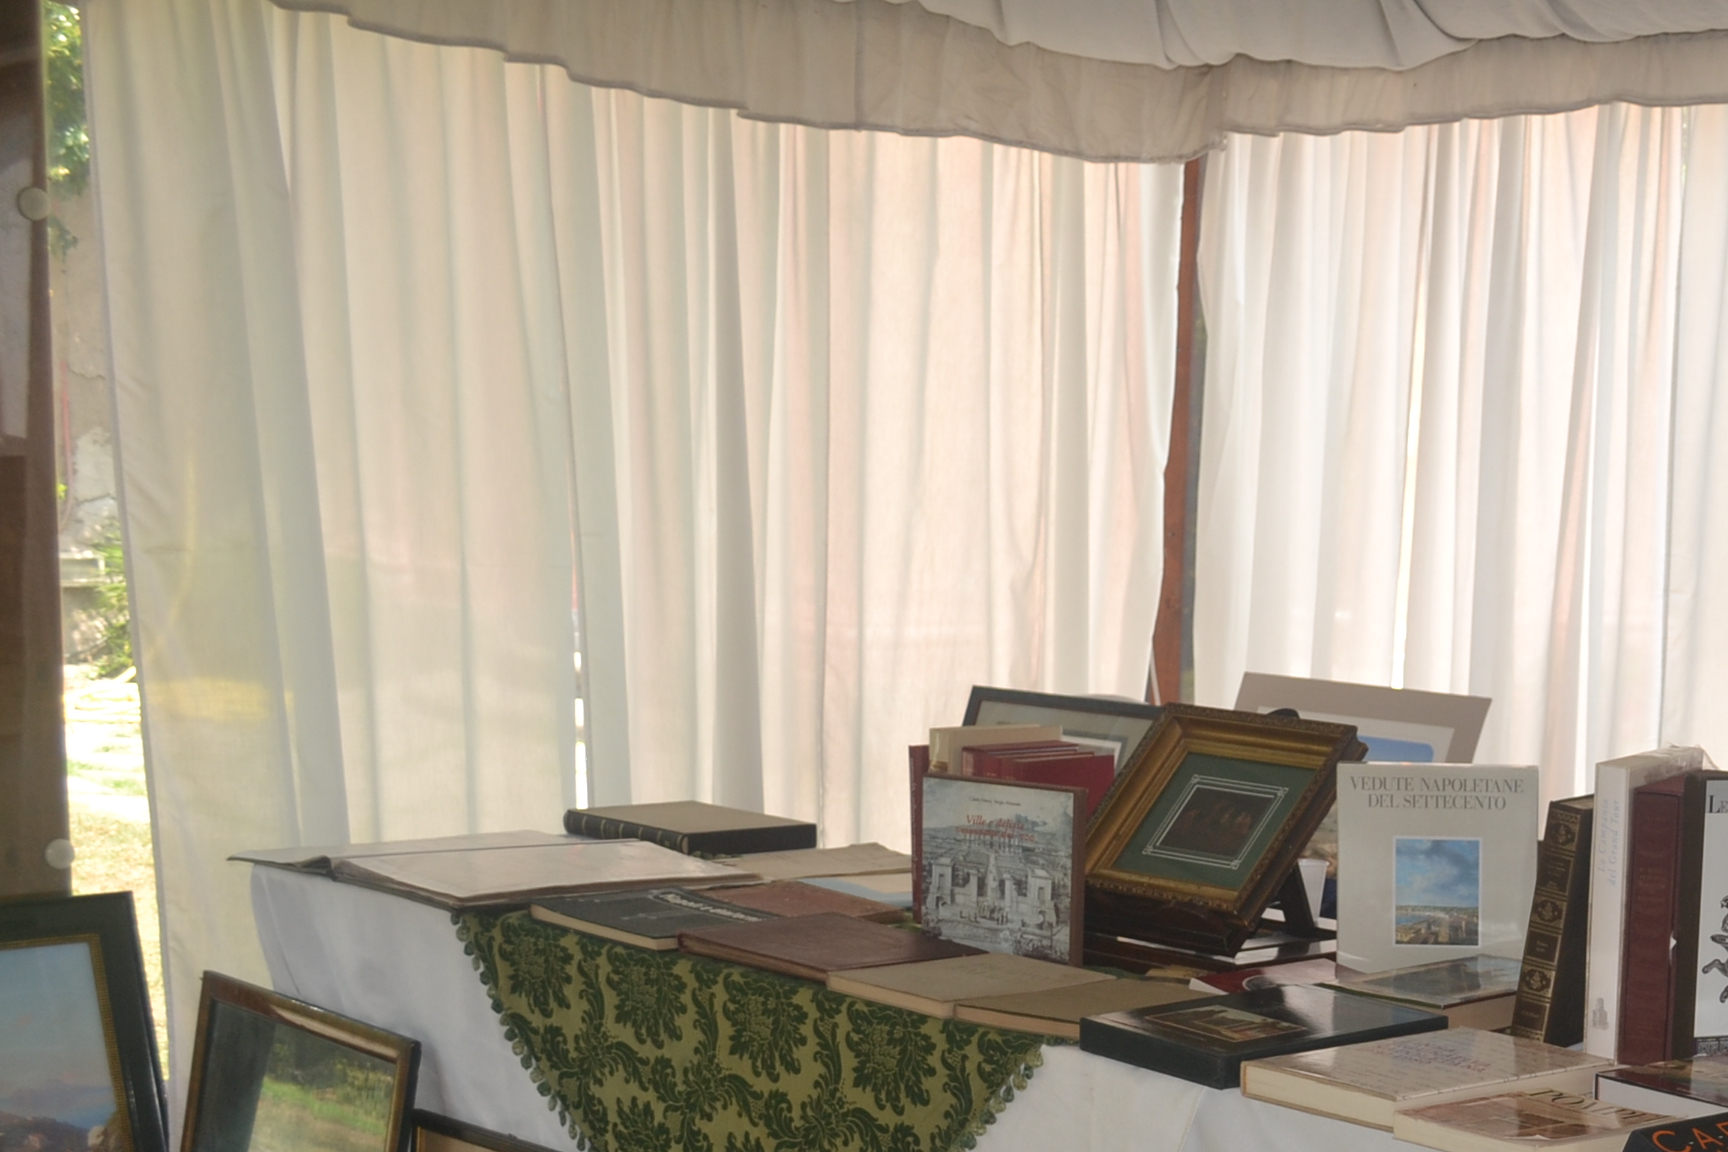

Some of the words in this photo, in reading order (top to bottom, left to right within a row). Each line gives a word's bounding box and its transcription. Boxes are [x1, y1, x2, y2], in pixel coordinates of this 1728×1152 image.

[1350, 775, 1415, 792] VEDUTE
[1419, 776, 1524, 794] NAPOLETANE
[1367, 793, 1401, 809] DEL
[1402, 794, 1507, 811] SETTECENTO
[1708, 794, 1728, 814] LE
[966, 813, 985, 827] Ville
[995, 816, 1026, 832] delizie
[1612, 799, 1620, 827] Tour
[1600, 799, 1610, 858] Campania
[1610, 830, 1619, 867] Grand
[1608, 871, 1617, 887] del
